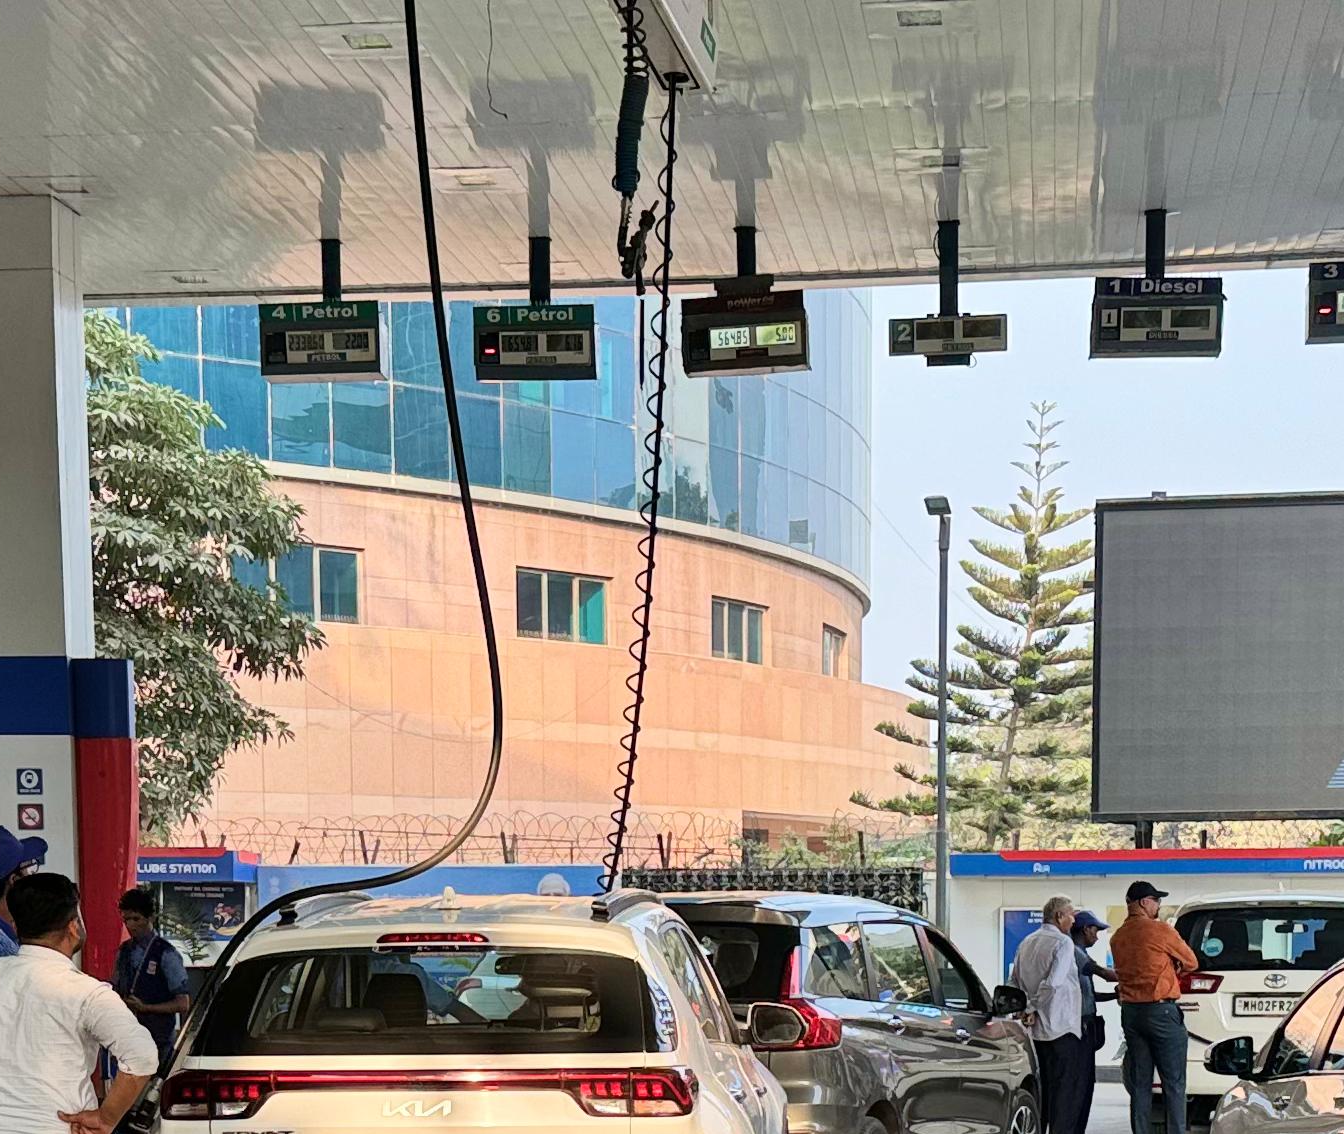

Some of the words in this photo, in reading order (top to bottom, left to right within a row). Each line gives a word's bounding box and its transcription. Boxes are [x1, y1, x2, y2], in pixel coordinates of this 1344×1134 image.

[1323, 263, 1338, 279] 3
[1109, 278, 1121, 293] 1
[1140, 278, 1203, 294] Diesel
[271, 304, 287, 320] 4
[301, 303, 358, 319] Petrol
[486, 308, 501, 323] 6
[516, 306, 574, 322] Petrol
[897, 323, 912, 342] 2
[137, 863, 168, 874] LUBE
[169, 863, 217, 874] STATION
